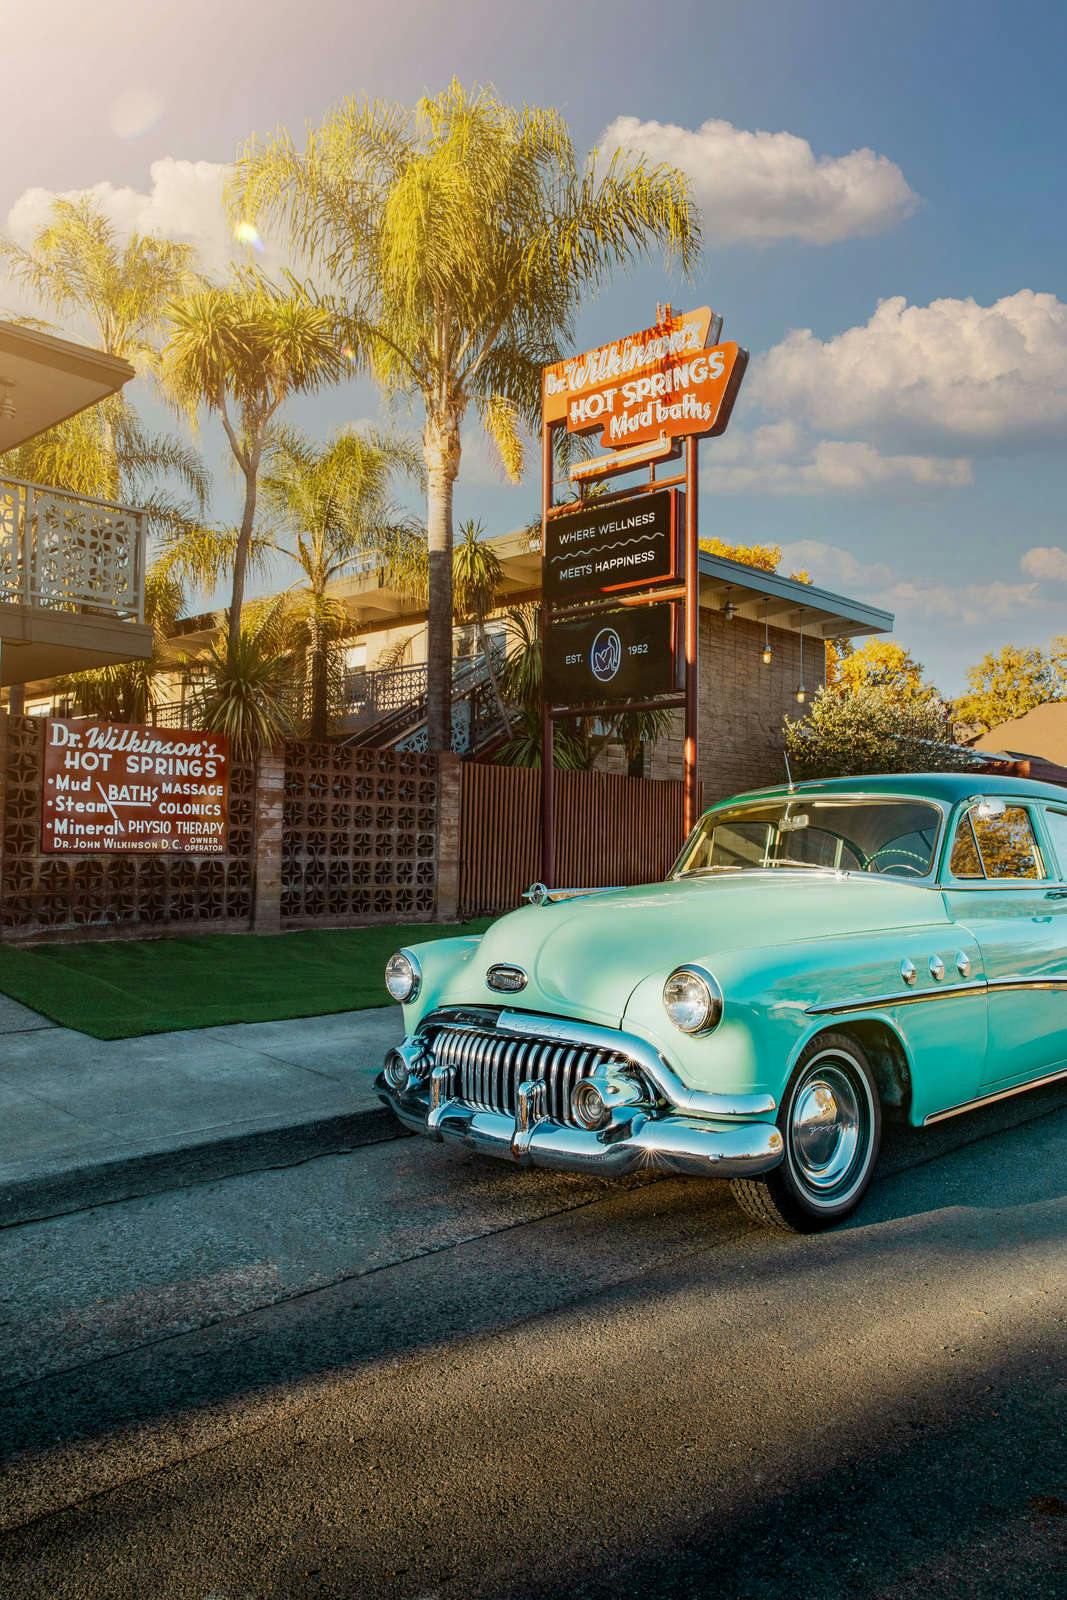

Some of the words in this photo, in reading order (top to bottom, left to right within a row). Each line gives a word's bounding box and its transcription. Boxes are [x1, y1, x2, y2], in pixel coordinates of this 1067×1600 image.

[569, 389, 617, 424] HOT
[622, 352, 725, 406] SPRINGS
[609, 400, 653, 440] Mud
[559, 527, 596, 545] WHERE
[599, 512, 655, 534] WELLNESS
[559, 564, 593, 580] MEETS
[595, 550, 655, 572] HAPPINESS
[565, 654, 584, 665] EST.
[627, 643, 649, 655] 1952
[50, 723, 84, 749] Dr.
[85, 727, 225, 762] Wilkinson's
[64, 751, 113, 771] HOT
[126, 754, 217, 778] SPRINGS
[108, 784, 159, 803] BATHS
[161, 782, 223, 797] MASSAGE
[158, 802, 221, 816] COLONICS
[128, 820, 172, 834] PHYSIO
[176, 821, 225, 835] THERAPY
[103, 838, 158, 850] WILKINSON
[184, 844, 223, 852] OPERATOR
